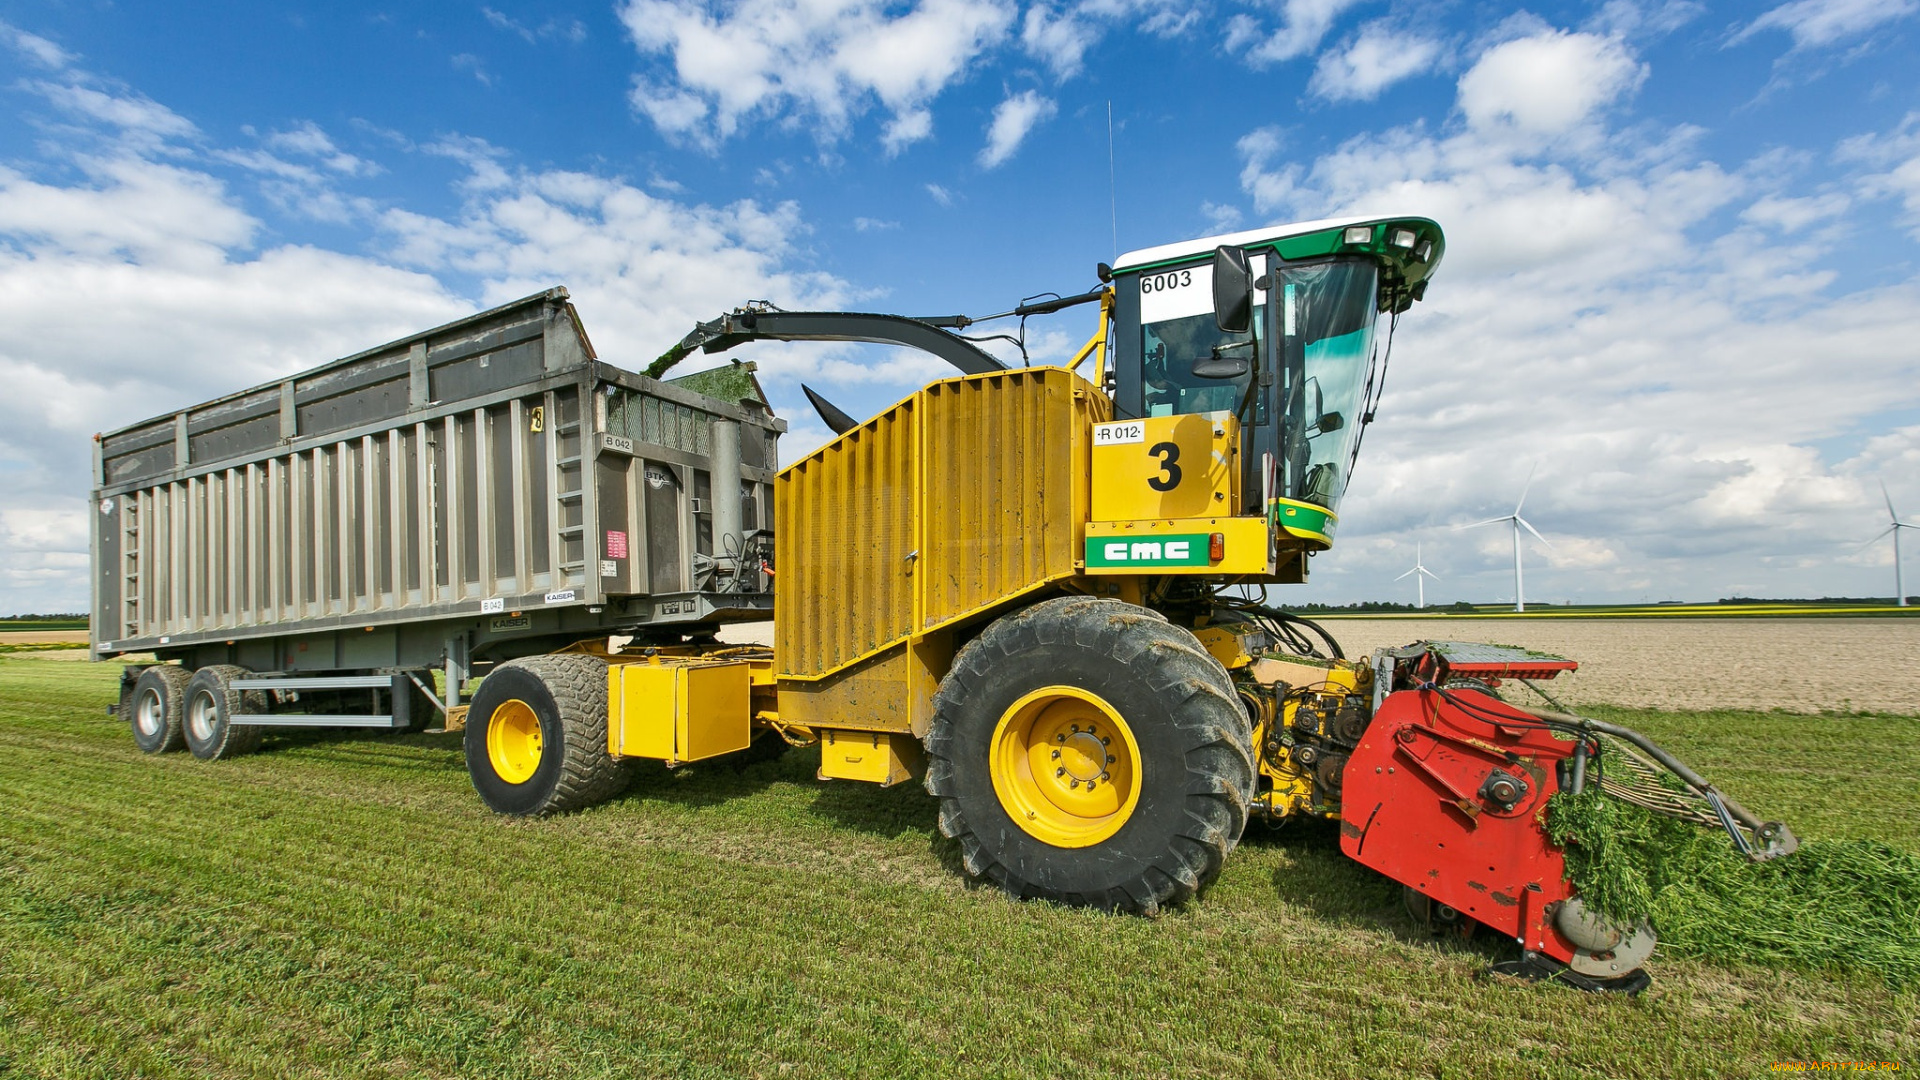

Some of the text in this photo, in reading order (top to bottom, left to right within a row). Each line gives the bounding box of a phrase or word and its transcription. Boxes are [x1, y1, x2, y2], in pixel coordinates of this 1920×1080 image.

[1141, 271, 1191, 294] 6003
[1147, 442, 1183, 492] 3
[645, 471, 667, 482] BTK
[546, 592, 574, 602] KAISER
[492, 618, 528, 629] KAISER
